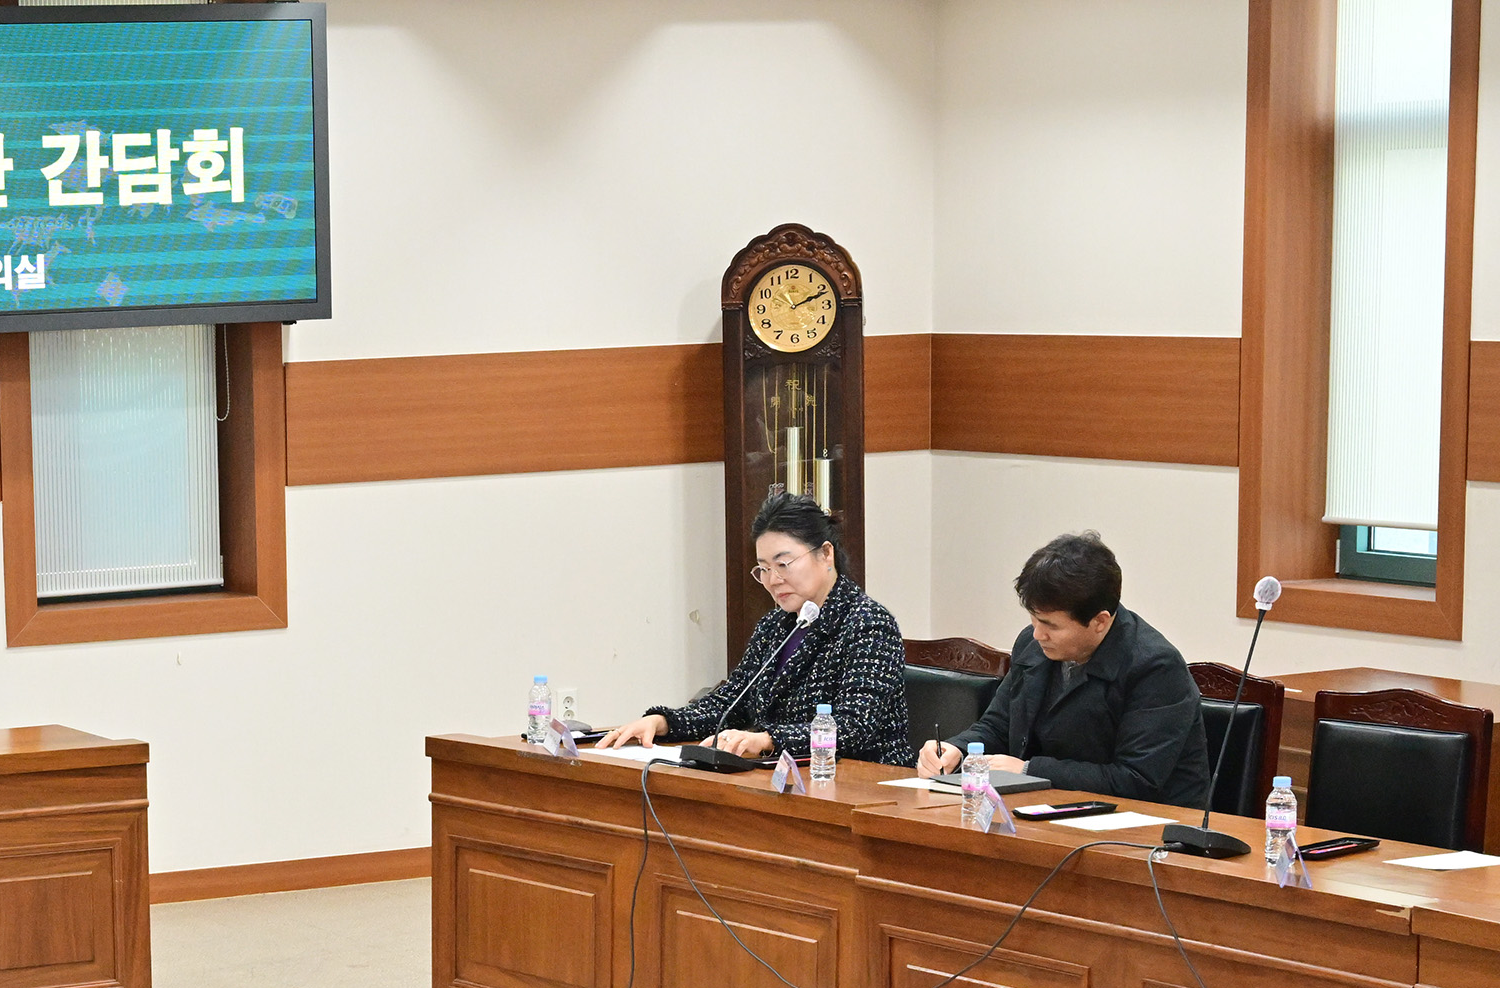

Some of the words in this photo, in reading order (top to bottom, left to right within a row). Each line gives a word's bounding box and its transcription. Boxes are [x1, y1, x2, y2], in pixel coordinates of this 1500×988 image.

[40, 126, 246, 207] 간담회
[785, 268, 799, 280] 12
[809, 273, 813, 283] 1
[770, 275, 781, 286] 11
[760, 288, 772, 299] 10
[817, 284, 827, 295] 2
[756, 304, 766, 314] 9
[822, 299, 832, 310] 3
[761, 318, 772, 329] 8
[817, 315, 826, 324] 4
[773, 330, 783, 340] 7
[790, 333, 800, 344] 6
[807, 328, 817, 338] 5
